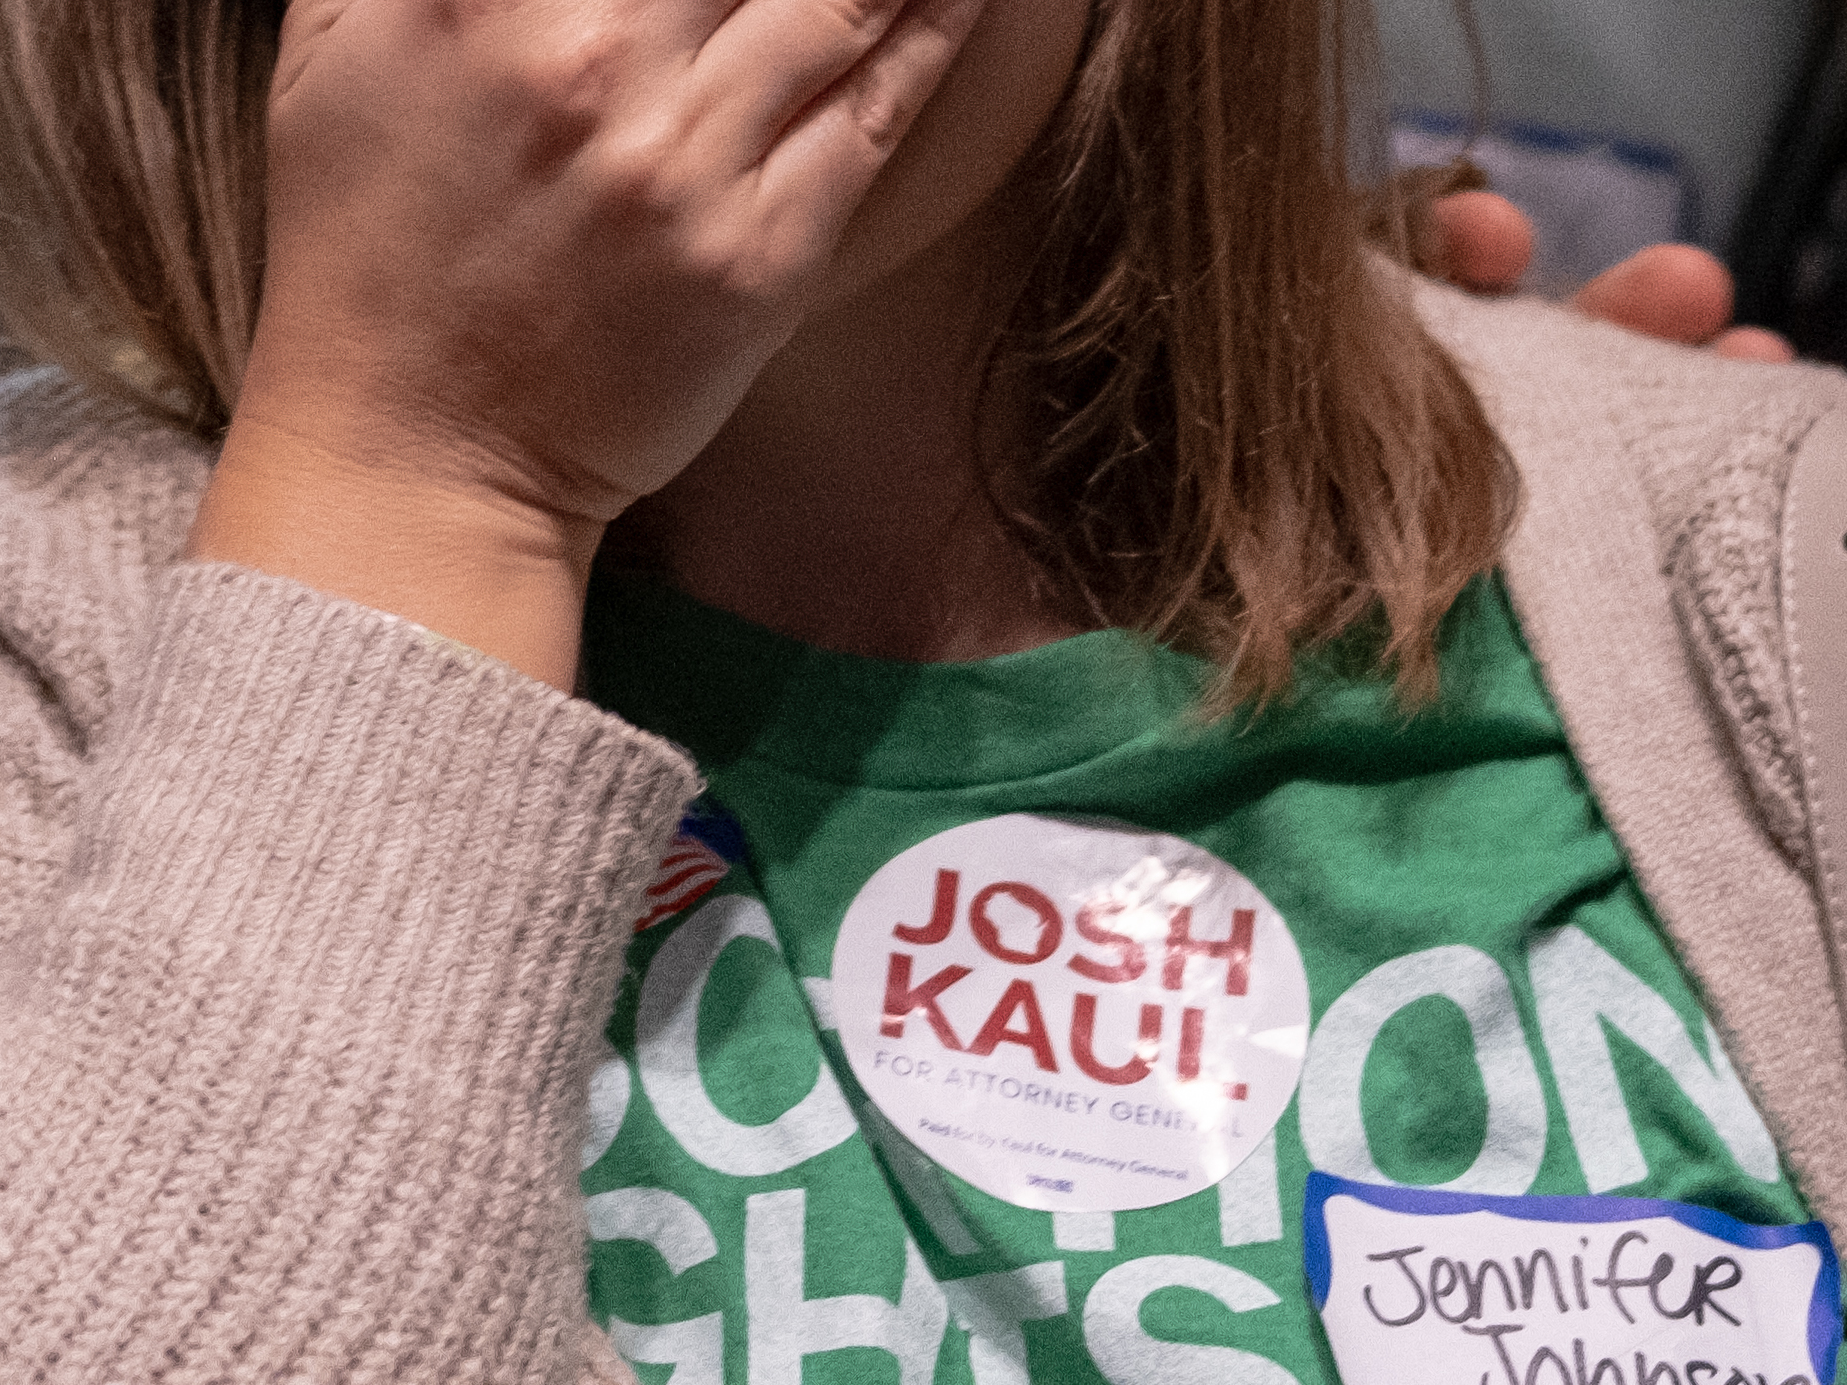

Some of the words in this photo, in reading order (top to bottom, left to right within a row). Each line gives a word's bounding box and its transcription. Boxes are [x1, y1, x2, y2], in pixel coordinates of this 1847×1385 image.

[890, 867, 1258, 997] JOSH
[872, 1047, 933, 1081] FOR
[943, 1066, 1100, 1116] ATTORNEY
[879, 951, 1249, 1102] KAUL
